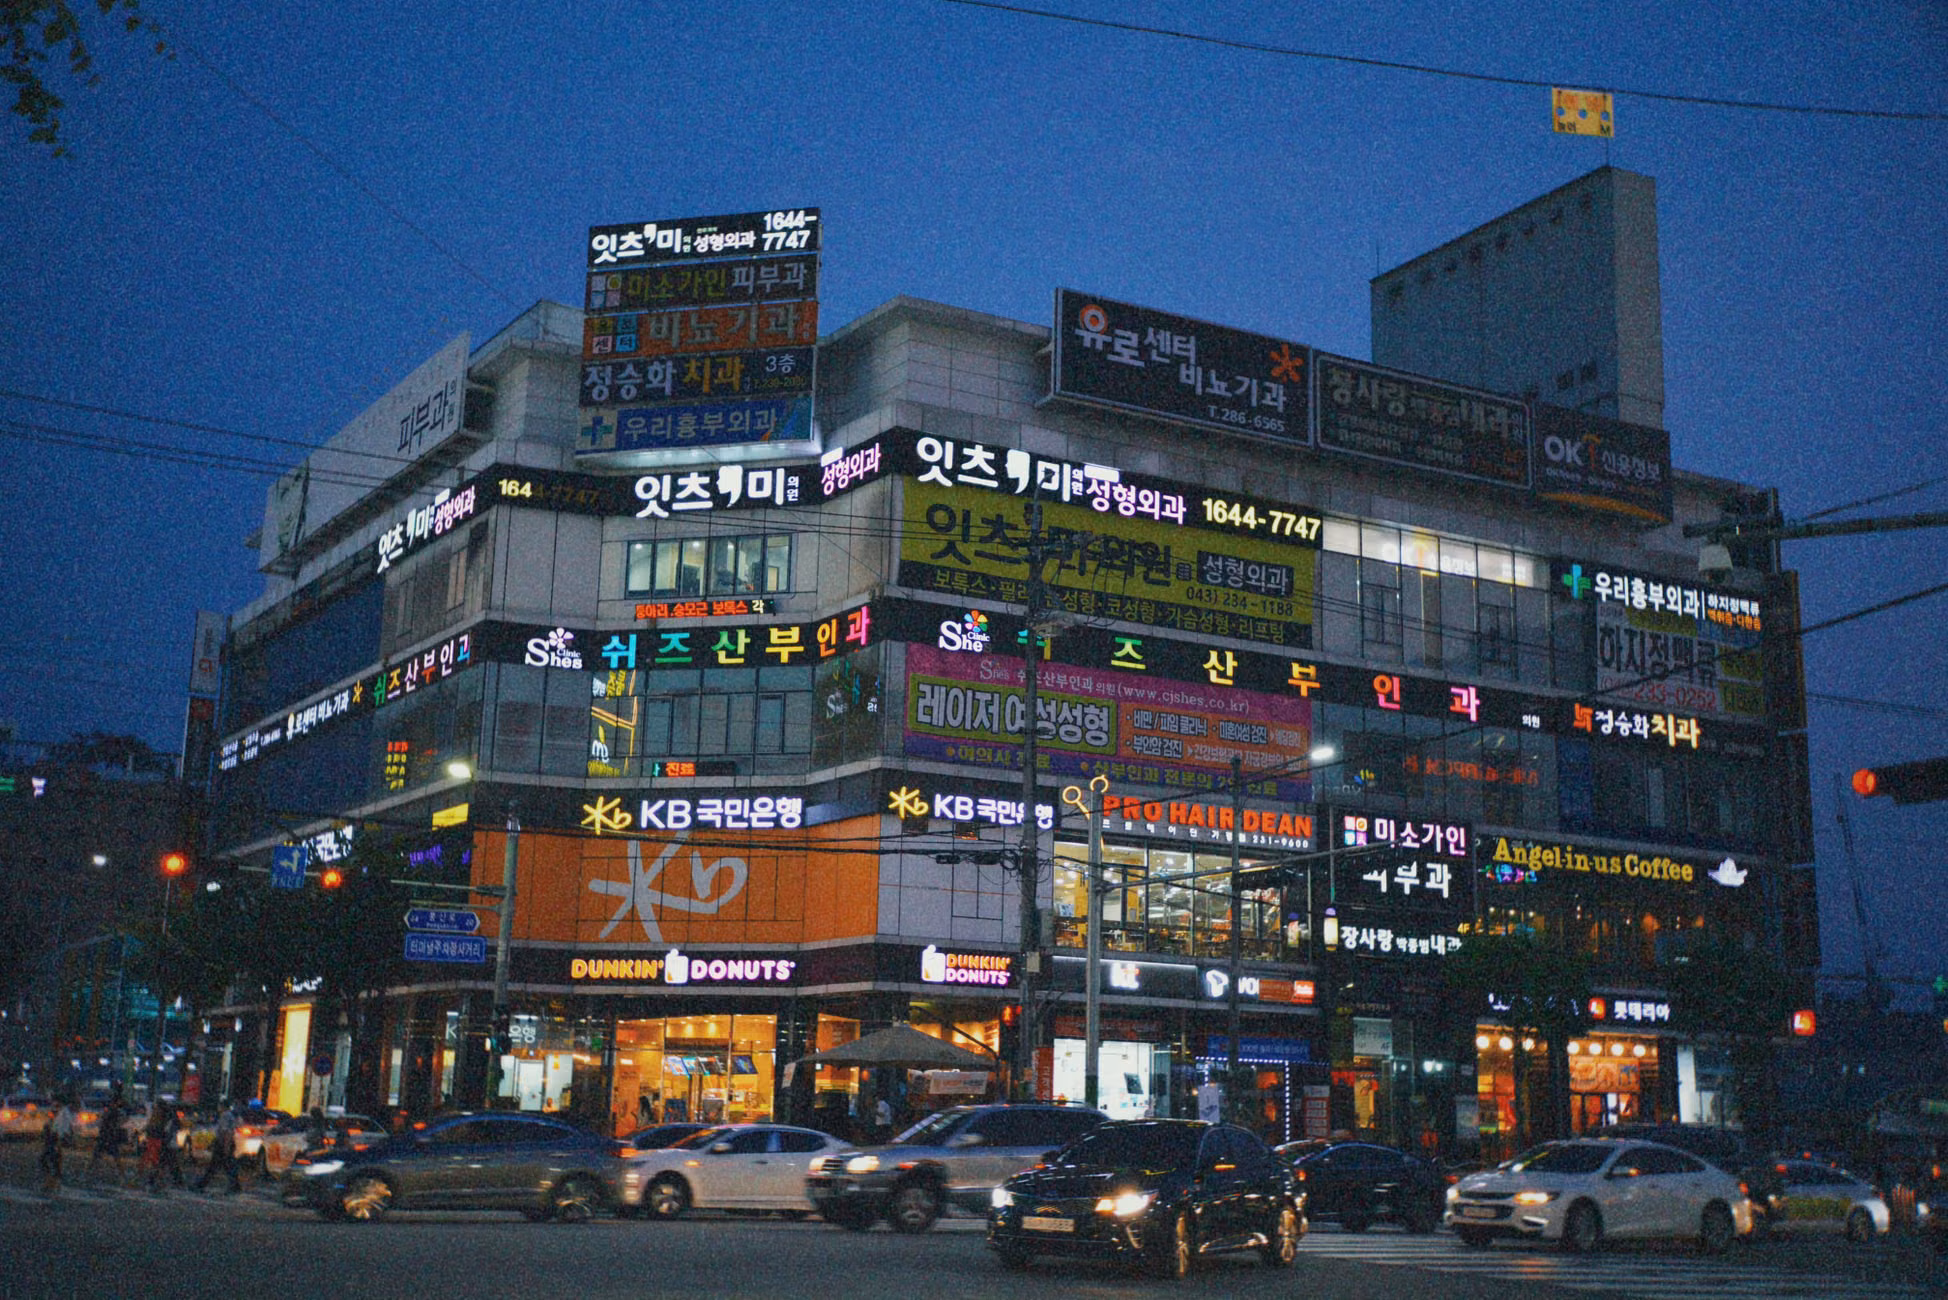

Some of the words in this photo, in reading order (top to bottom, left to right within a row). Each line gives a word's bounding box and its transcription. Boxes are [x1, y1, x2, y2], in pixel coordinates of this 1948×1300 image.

[764, 211, 817, 231] 1644-
[694, 231, 756, 253] 성형외과
[762, 231, 811, 251] 7747
[627, 268, 727, 300] 미소가인
[732, 262, 807, 296] 피부과
[649, 304, 799, 348] 비뇨기과
[1074, 304, 1196, 368] 유로센터
[584, 359, 677, 401] 정승화
[683, 356, 745, 394] 치과
[765, 353, 796, 374] 3층
[1179, 362, 1287, 413] 비뇨기과
[397, 380, 449, 455] 피부과
[623, 407, 778, 441] 우리흉부외과
[820, 442, 882, 496] 성형외과
[434, 485, 476, 535] 성형외과
[1085, 477, 1187, 526] 성형외과
[1201, 498, 1322, 542] 1644-7747
[1202, 555, 1289, 596] 성형외과
[712, 599, 749, 616] 보톡스
[751, 599, 765, 615] 각
[1594, 571, 1700, 620] 우리흉부외과
[1239, 617, 1285, 645] 리프팅
[1095, 683, 1116, 696] 의원
[916, 682, 1000, 734] 레이저
[1004, 694, 1111, 747] 여성성형
[1133, 709, 1154, 730] 비만
[1521, 713, 1541, 729] 의원
[1595, 710, 1650, 740] 정승화
[1650, 713, 1701, 750] 치과
[1162, 737, 1184, 759] 검진
[1103, 795, 1162, 823] PRO
[1169, 800, 1234, 830] HAIR
[1243, 809, 1312, 840] DEAN
[1374, 816, 1466, 857] 미소가인
[1624, 853, 1694, 883] Coffee
[1339, 925, 1395, 953] 장사랑
[571, 957, 664, 979] DUNKIN'
[691, 959, 791, 980] DONUTS
[945, 953, 1010, 972] DUNKIN'
[945, 969, 1010, 988] DONUTS
